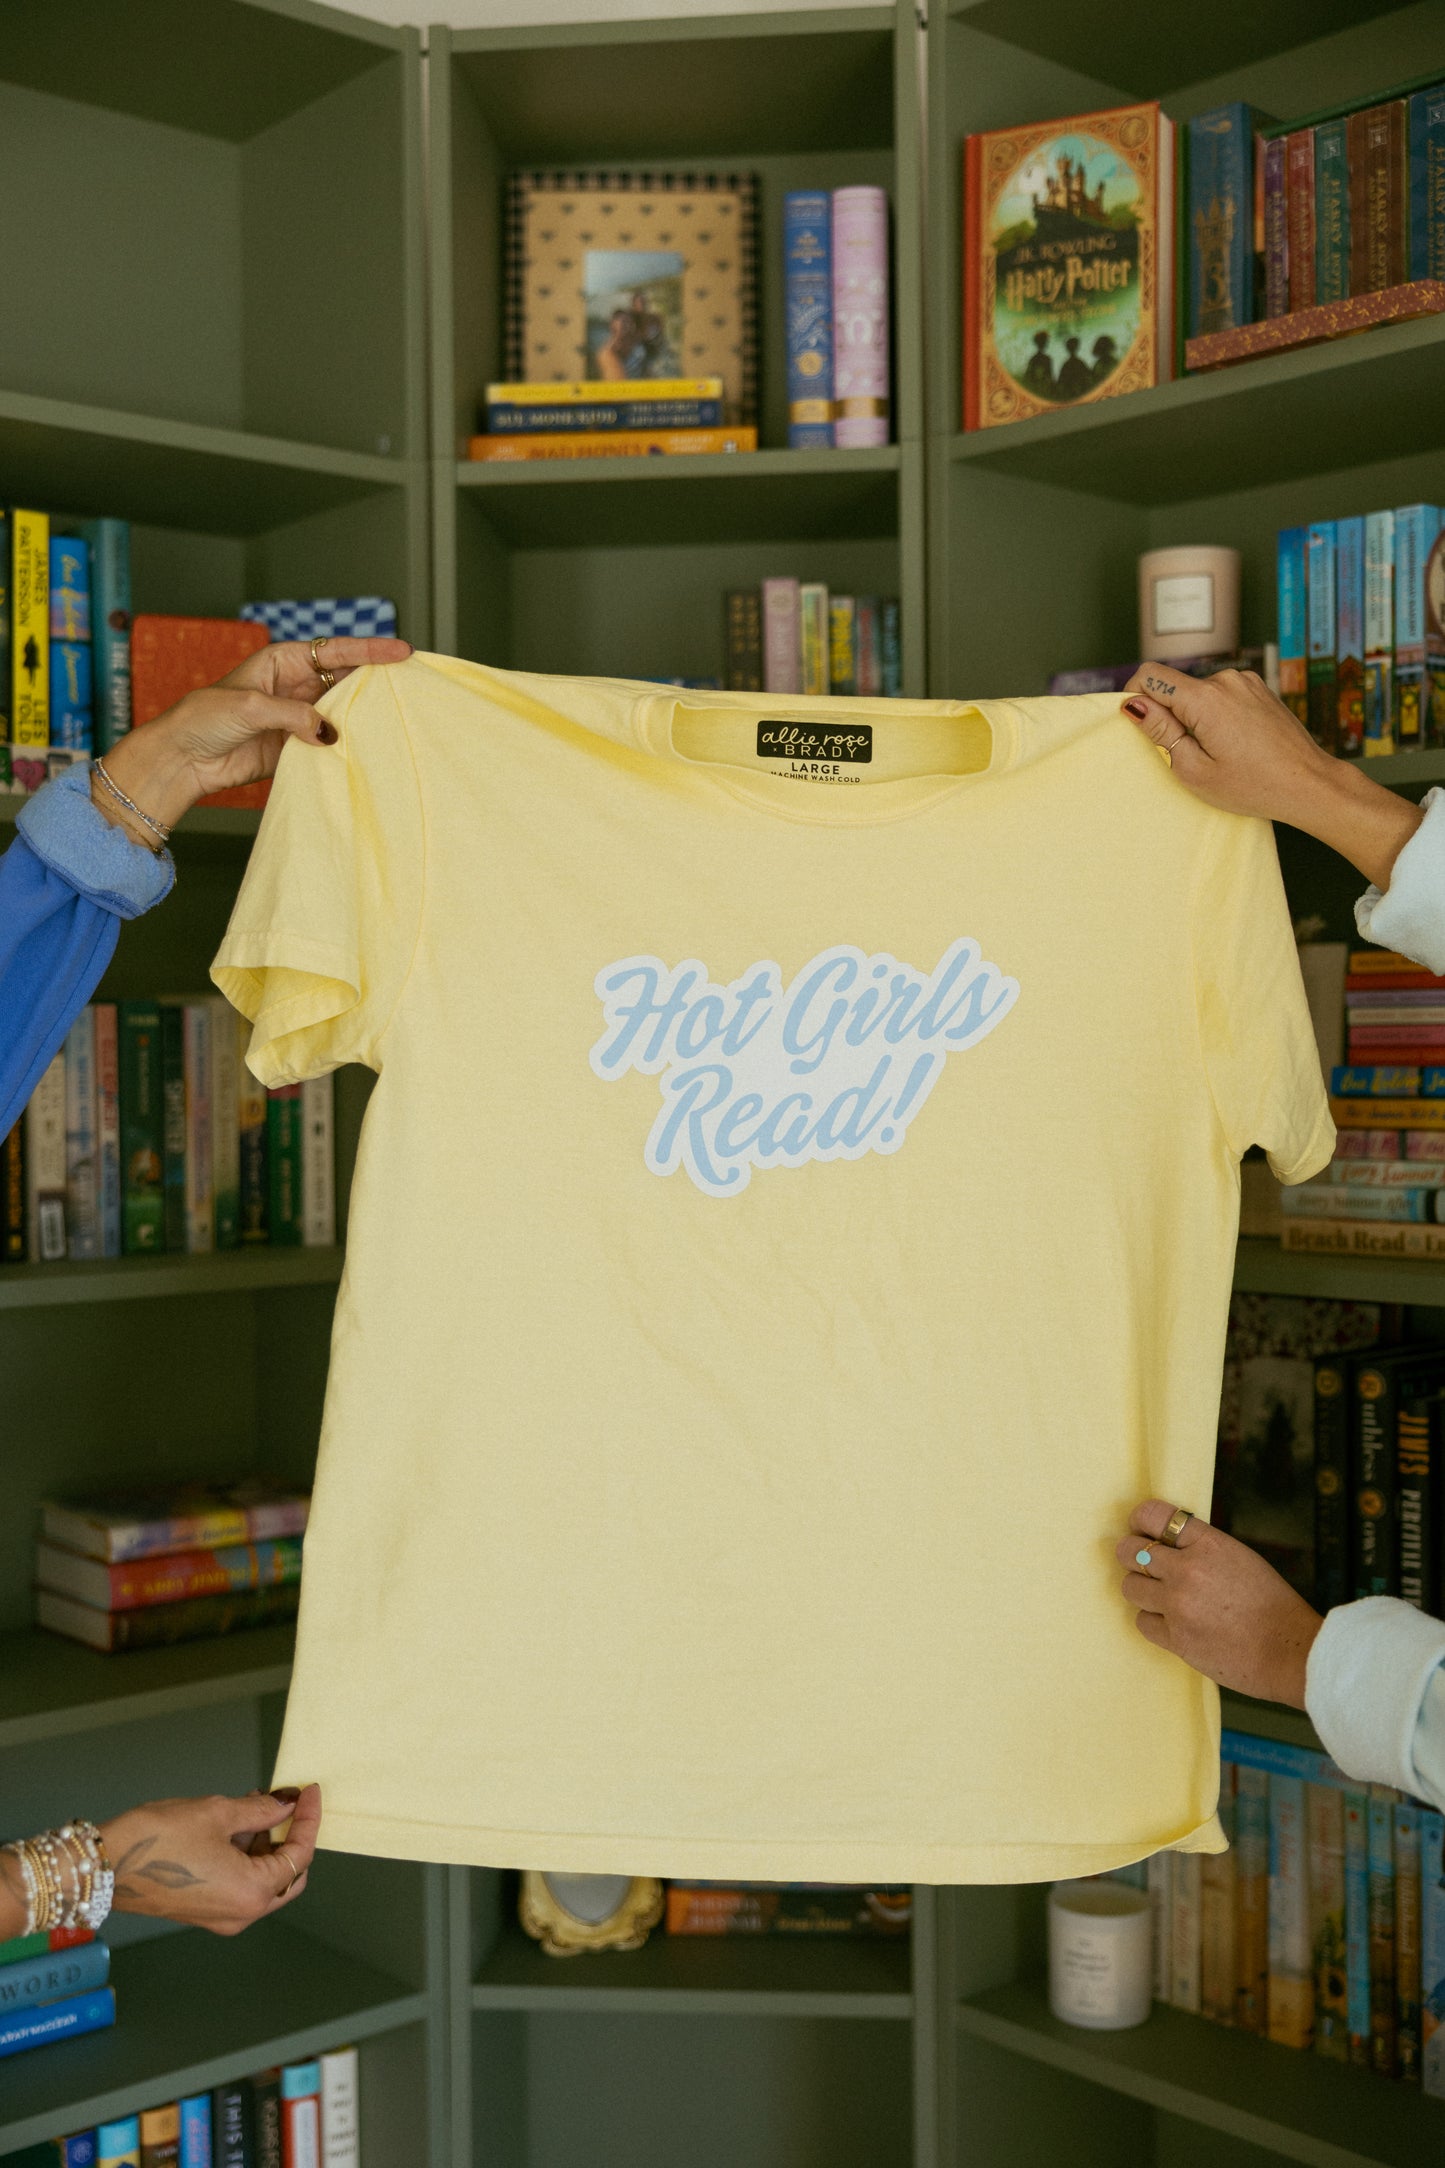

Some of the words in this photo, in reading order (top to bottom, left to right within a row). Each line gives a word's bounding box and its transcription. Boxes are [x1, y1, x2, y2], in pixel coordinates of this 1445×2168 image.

[1004, 267, 1066, 312] Harry
[1065, 255, 1131, 300] Potter
[18, 525, 31, 627] PATTERSON
[34, 549, 48, 605] JAMES
[1146, 677, 1176, 697] 5,714
[19, 693, 32, 745] TOLD
[761, 726, 820, 746] allie
[823, 733, 869, 748] rose
[784, 744, 858, 759] BRADY
[791, 762, 841, 775] LARGE
[811, 772, 835, 782] WASH
[837, 776, 861, 784] COLD
[600, 966, 774, 1069] Hot
[782, 948, 1009, 1075] Girls
[655, 1052, 936, 1186] Read!
[1353, 1229, 1407, 1252] Read
[1398, 1410, 1430, 1476] JAMES
[1, 1962, 82, 2001] WORD
[0, 2027, 28, 2045] ARAH
